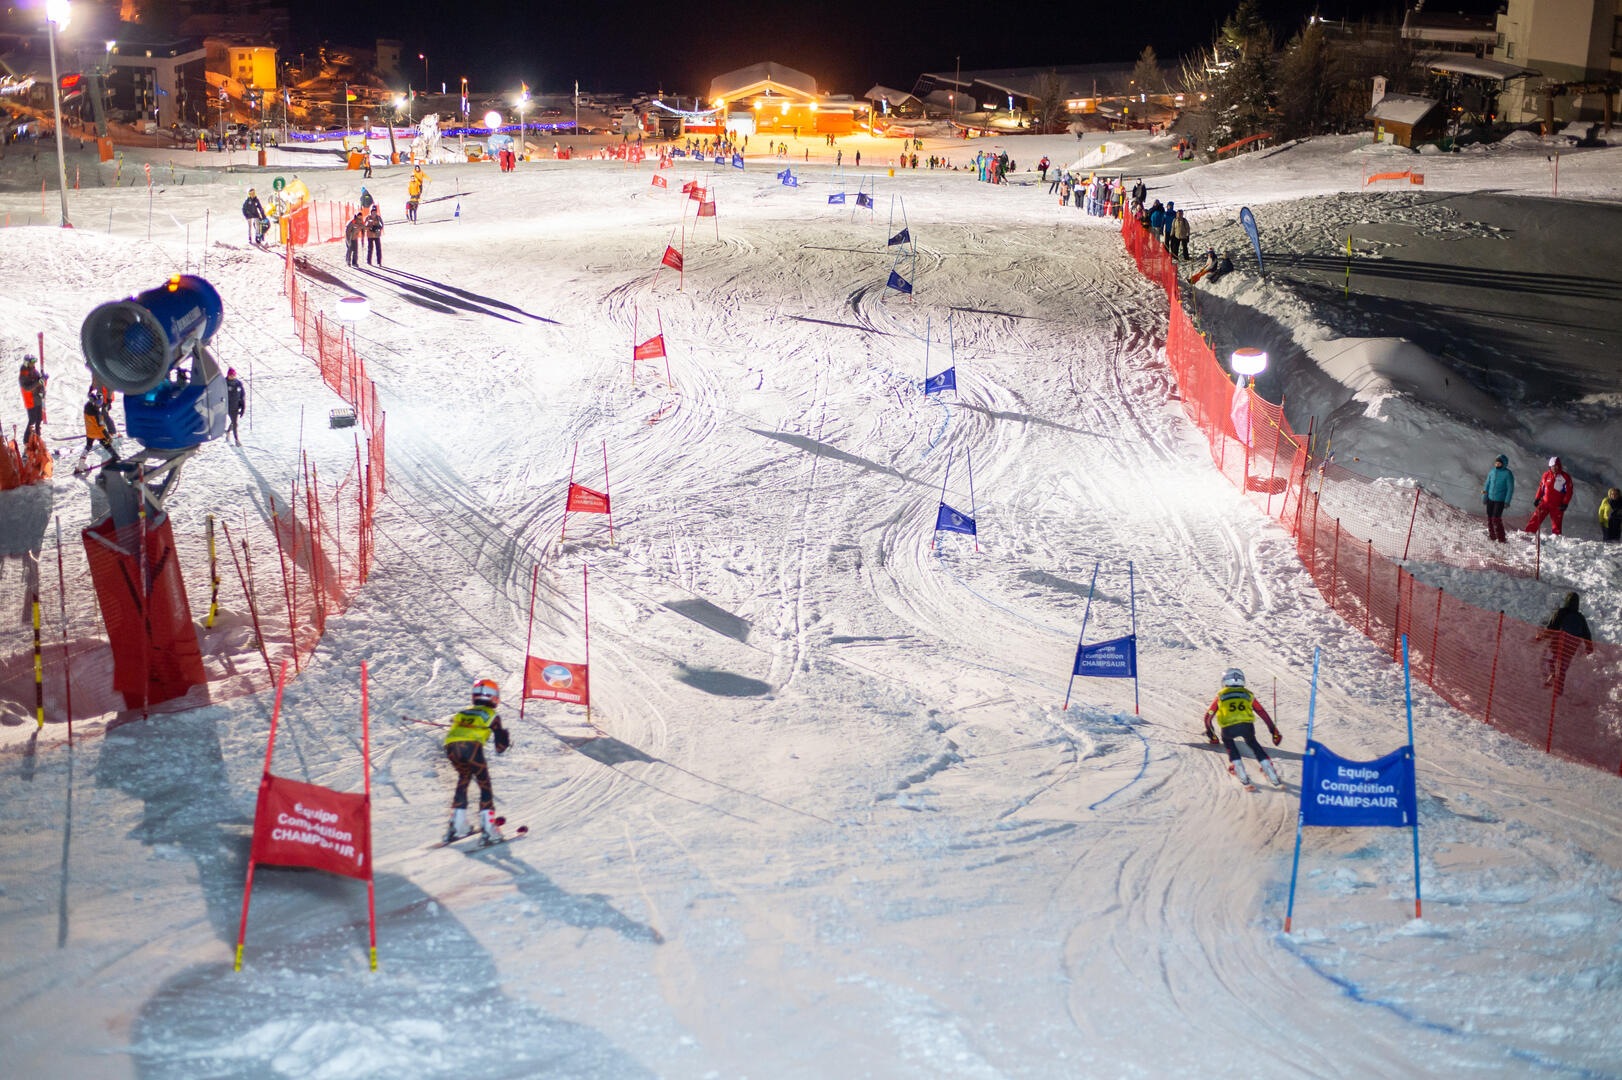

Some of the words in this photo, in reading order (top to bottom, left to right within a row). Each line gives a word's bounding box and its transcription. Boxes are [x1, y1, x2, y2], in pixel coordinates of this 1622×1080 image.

[1229, 702, 1246, 712] 56
[1321, 779, 1394, 795] Compétition
[1316, 793, 1399, 808] CHAMPSAUR
